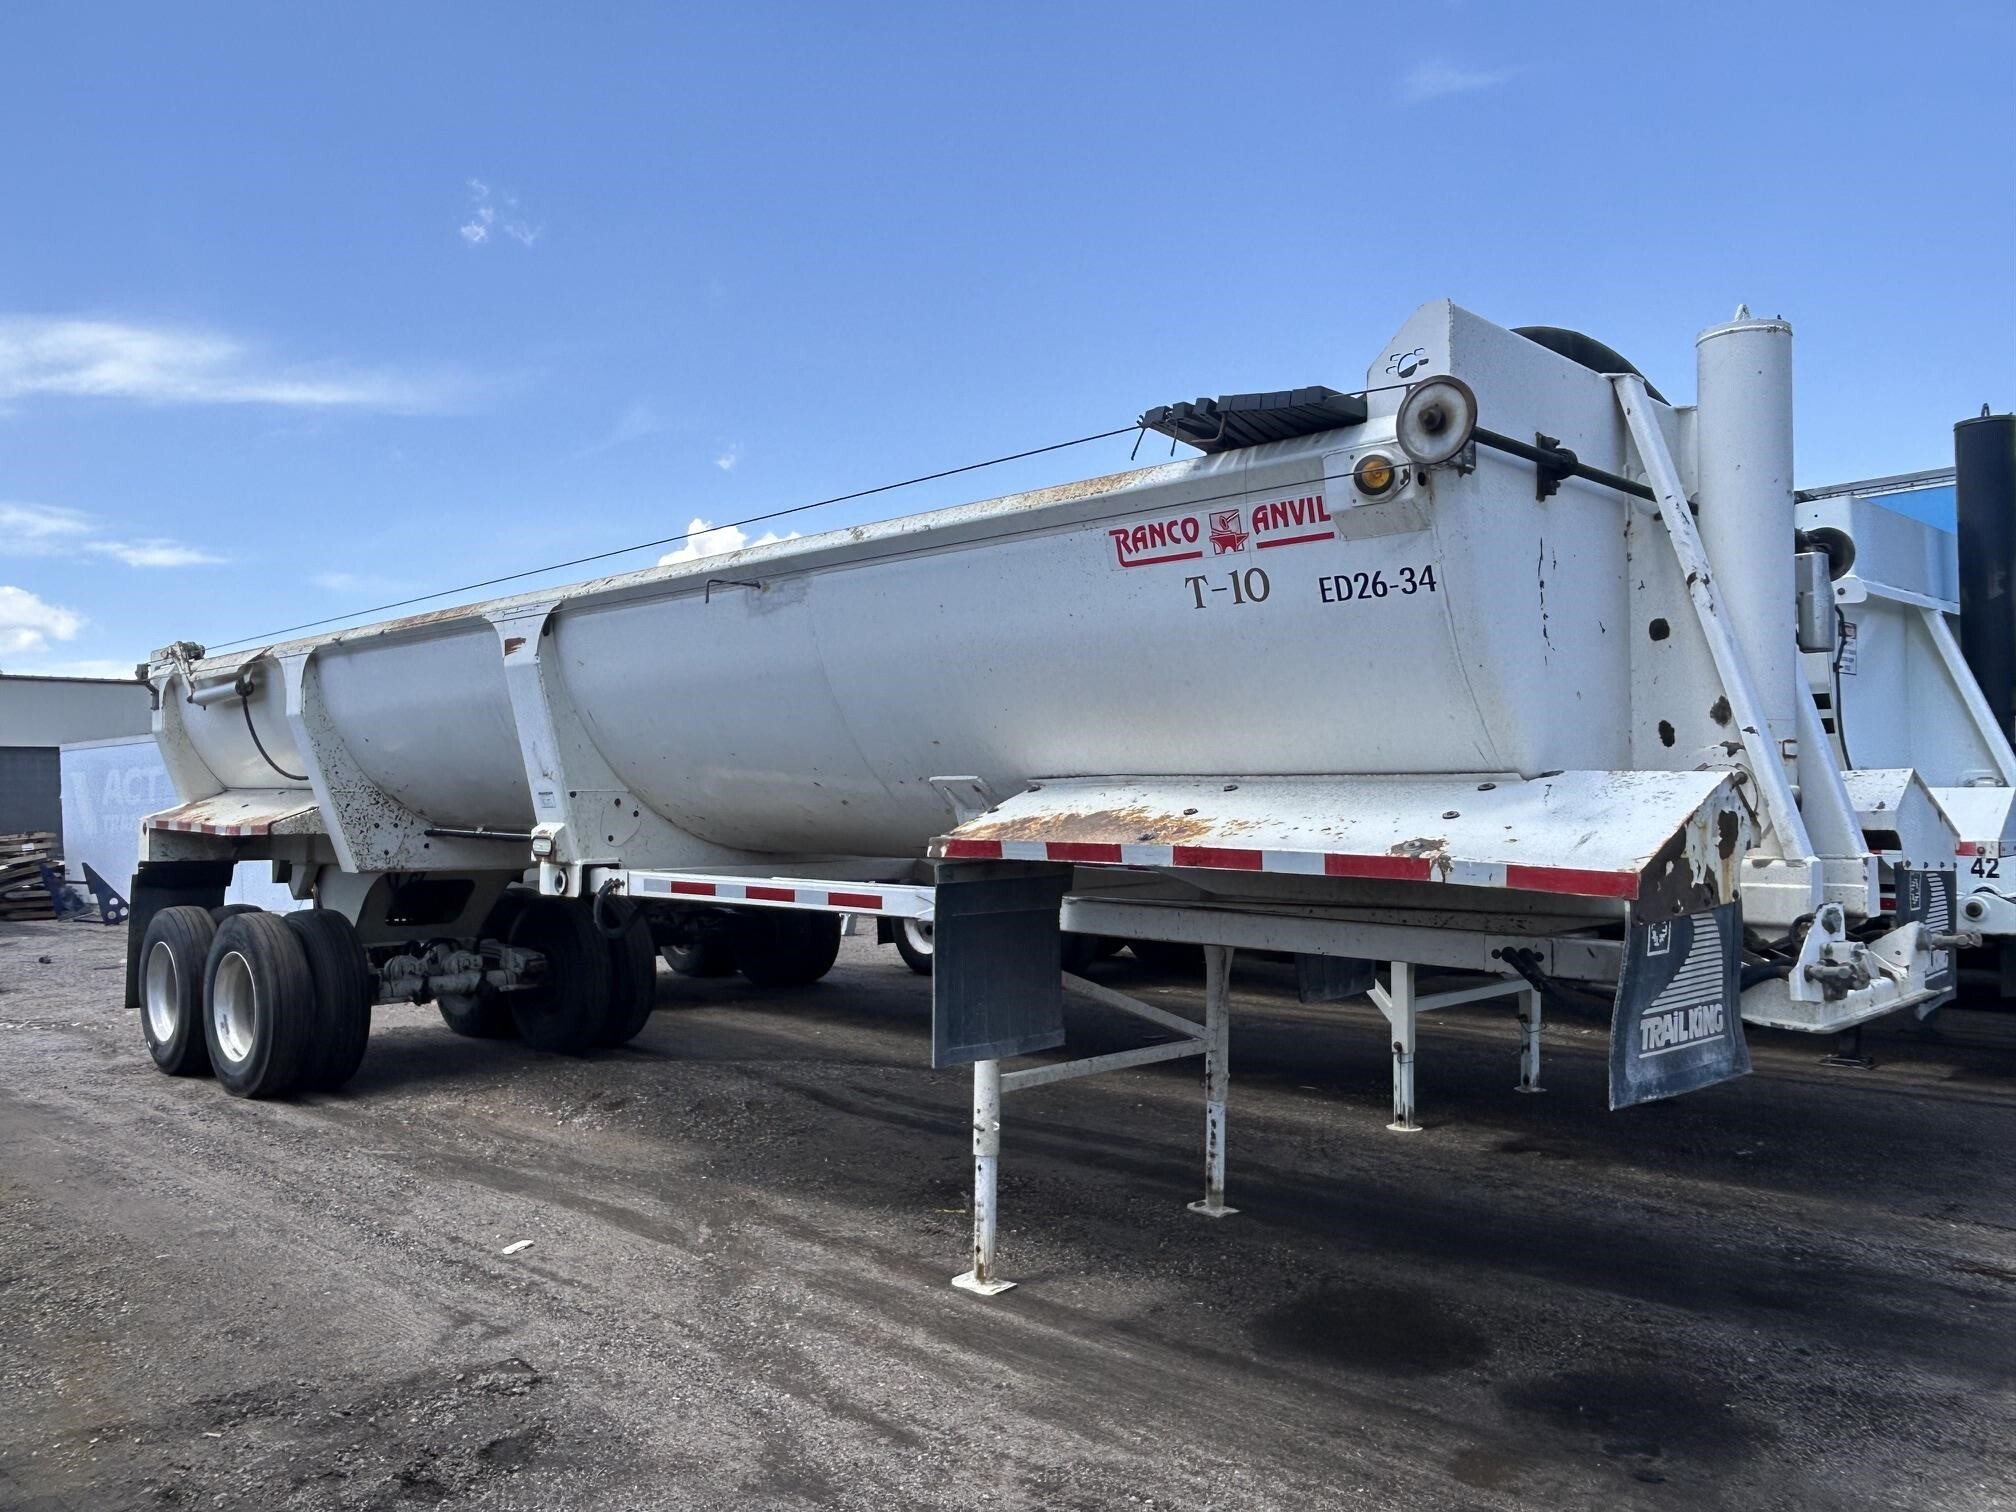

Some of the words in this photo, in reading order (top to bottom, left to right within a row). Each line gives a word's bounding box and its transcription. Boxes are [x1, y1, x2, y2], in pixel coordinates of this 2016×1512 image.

[1109, 517, 1200, 557] RANCO
[1252, 496, 1331, 535] ANVIL
[1185, 567, 1270, 609] T-10
[1319, 565, 1436, 603] ED26-34
[1971, 857, 2000, 878] 42
